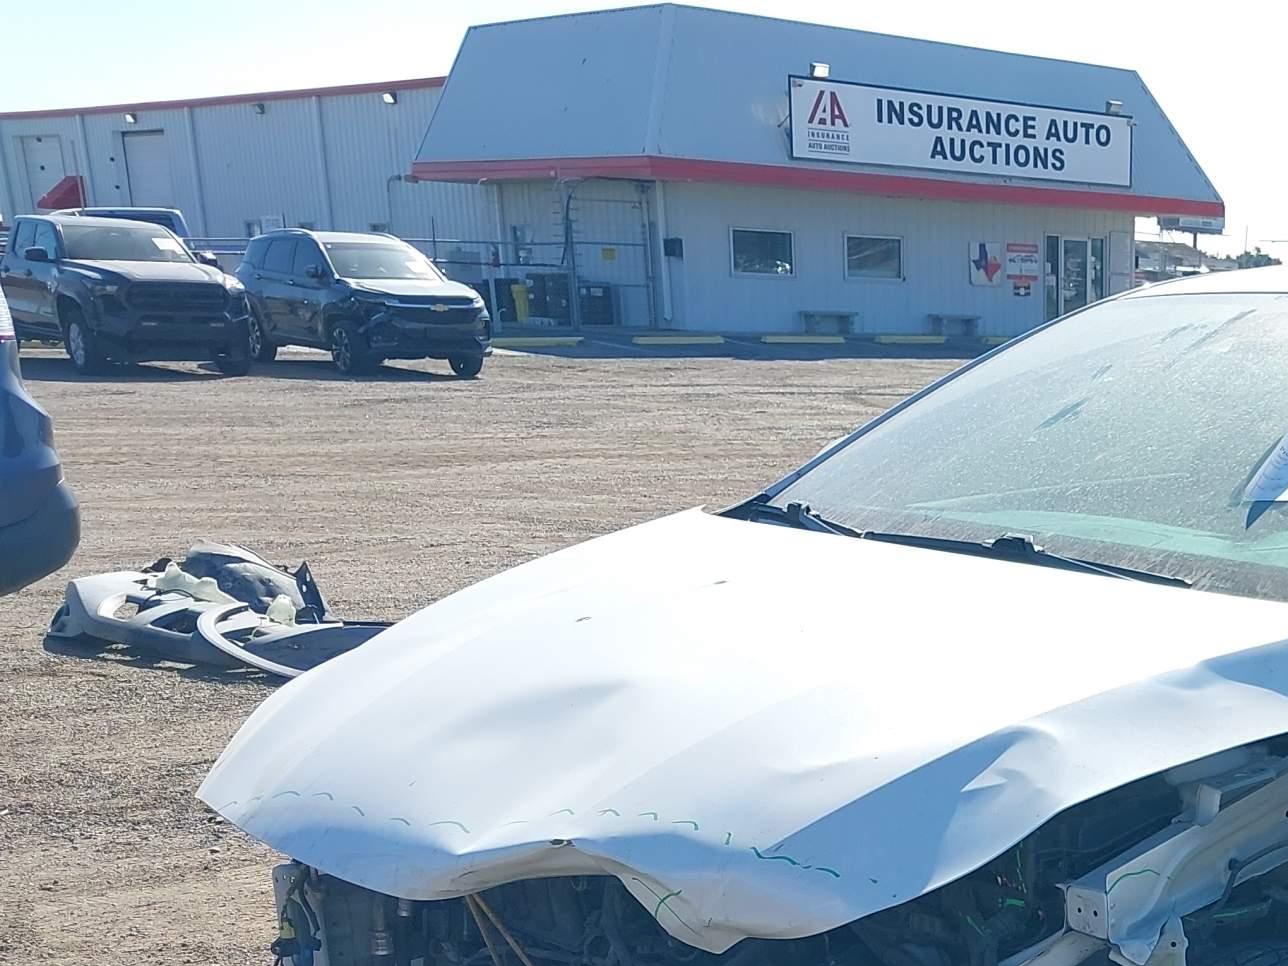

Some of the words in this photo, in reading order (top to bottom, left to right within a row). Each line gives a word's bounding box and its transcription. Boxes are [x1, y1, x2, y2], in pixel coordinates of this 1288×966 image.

[876, 98, 1036, 139] INSURANCE
[1045, 118, 1111, 147] AUTO
[929, 135, 1066, 172] AUCTIONS
